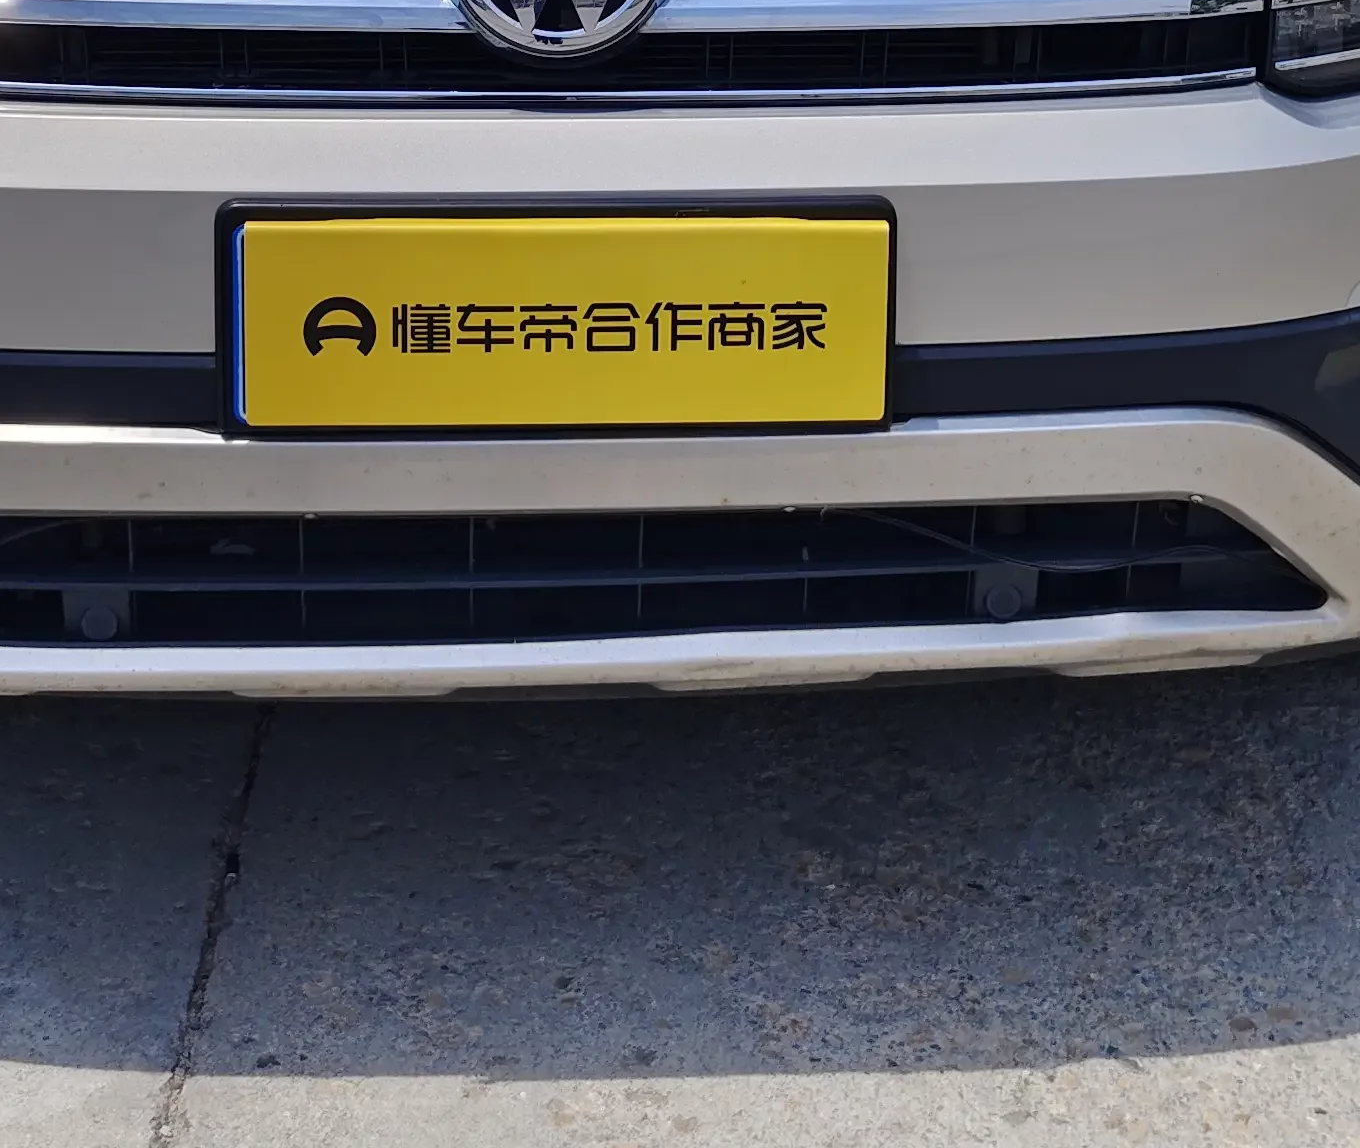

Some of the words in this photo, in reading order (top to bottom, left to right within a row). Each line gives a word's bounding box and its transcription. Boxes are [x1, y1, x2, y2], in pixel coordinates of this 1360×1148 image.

[391, 300, 827, 354] 懂车帝合作商家
